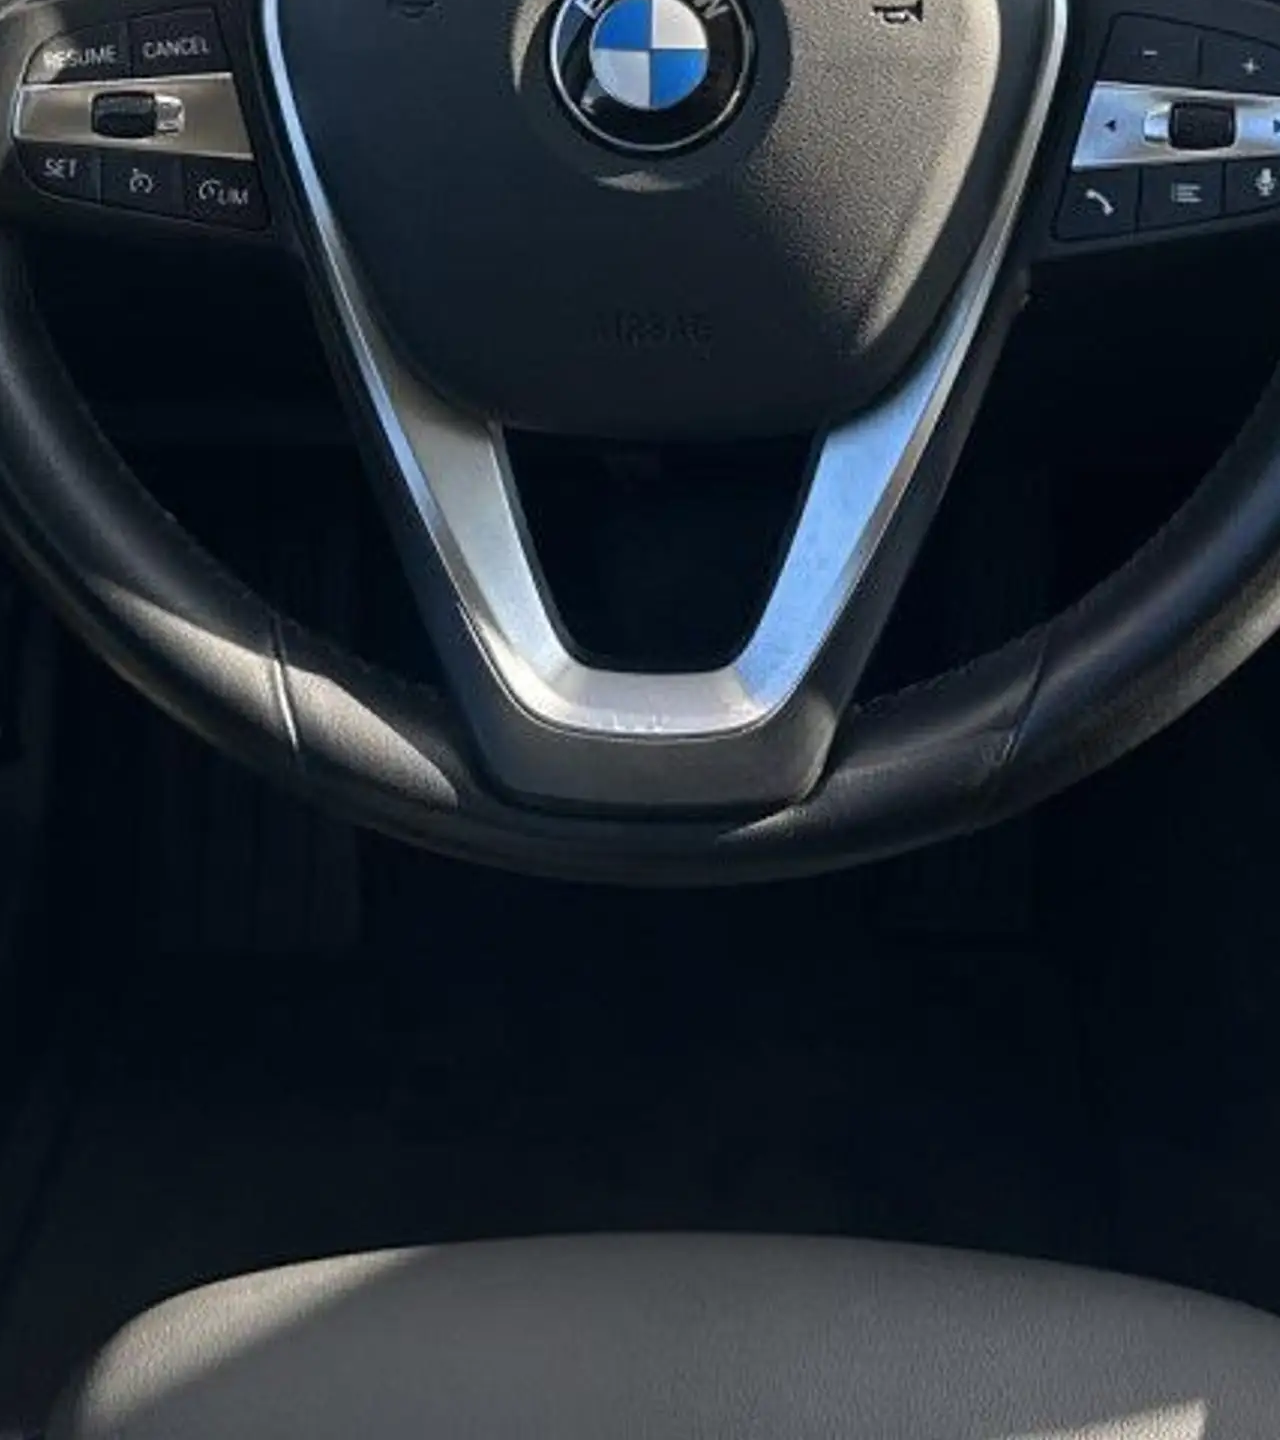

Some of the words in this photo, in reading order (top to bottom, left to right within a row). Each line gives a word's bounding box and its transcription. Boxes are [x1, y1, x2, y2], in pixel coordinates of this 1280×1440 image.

[42, 44, 119, 69] RESUME
[141, 34, 210, 60] CANCEL
[44, 158, 76, 179] SET
[219, 188, 249, 205] LIM
